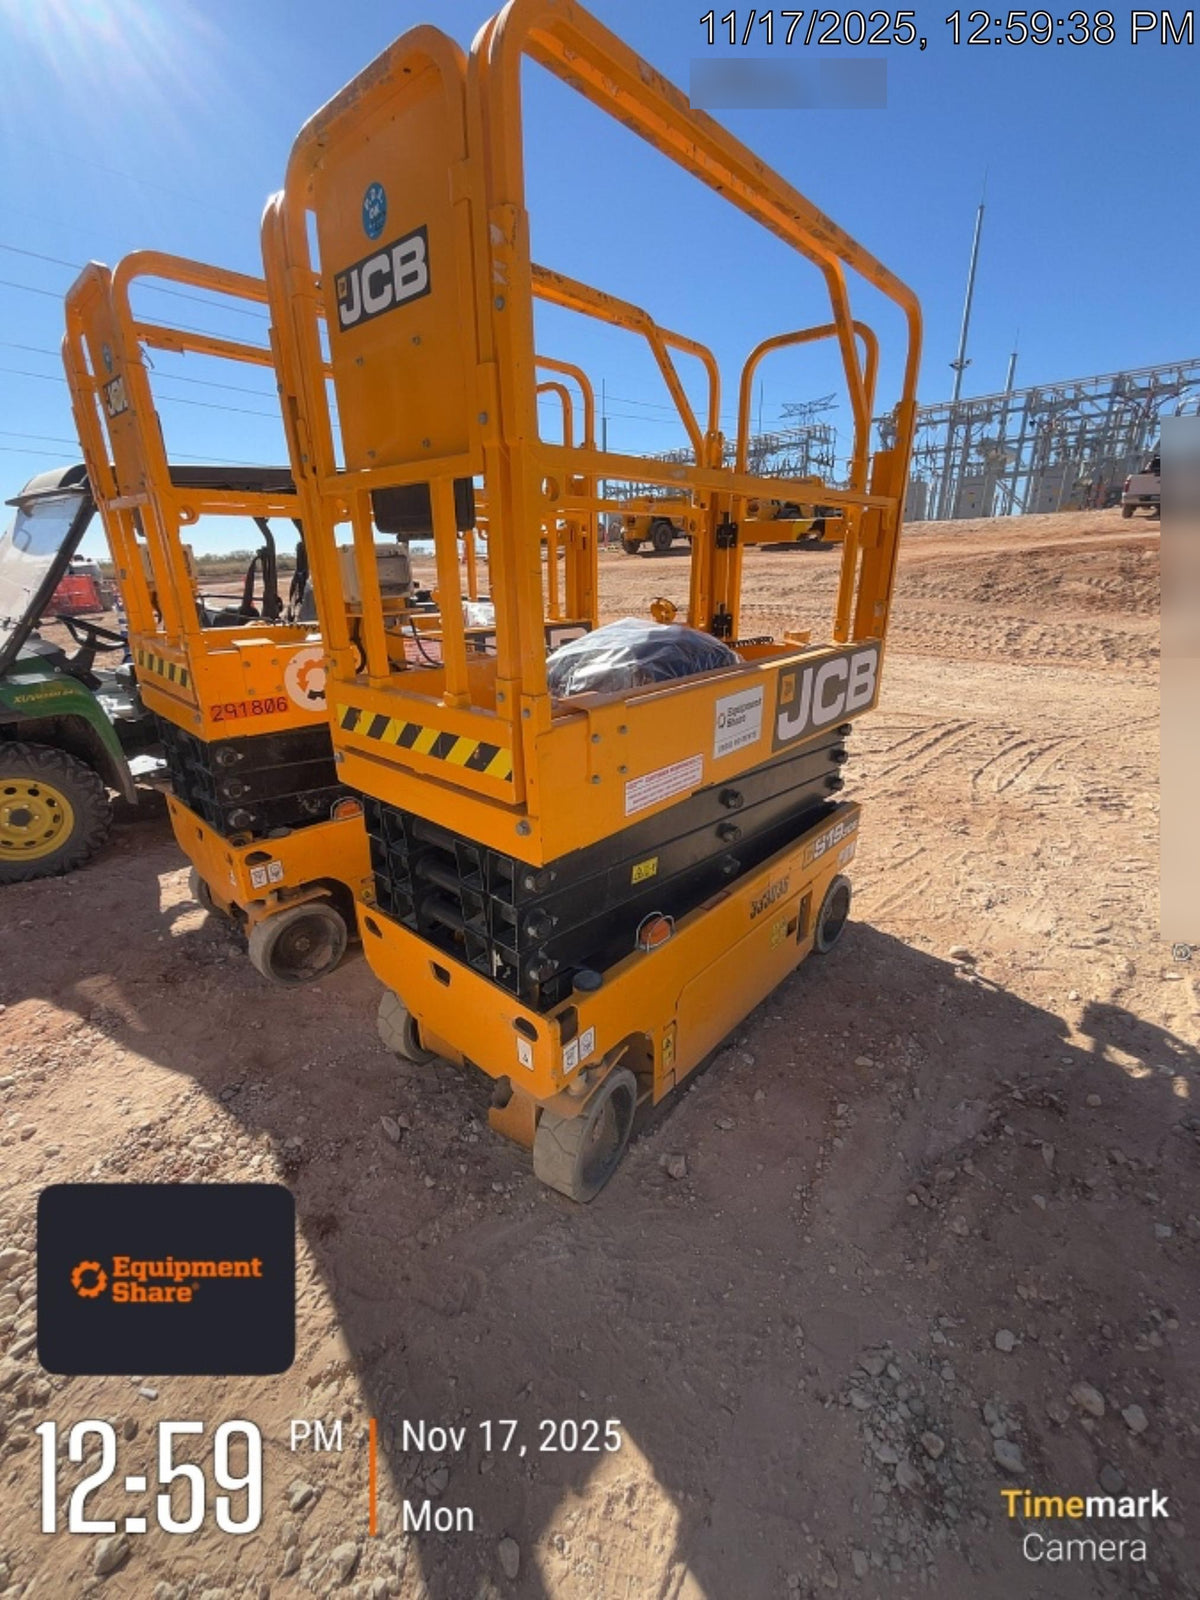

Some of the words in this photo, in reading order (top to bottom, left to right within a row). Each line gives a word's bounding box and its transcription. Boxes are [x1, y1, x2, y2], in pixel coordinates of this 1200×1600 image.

[340, 235, 428, 325] JCB
[210, 696, 288, 722] 291806
[777, 648, 878, 741] JCB
